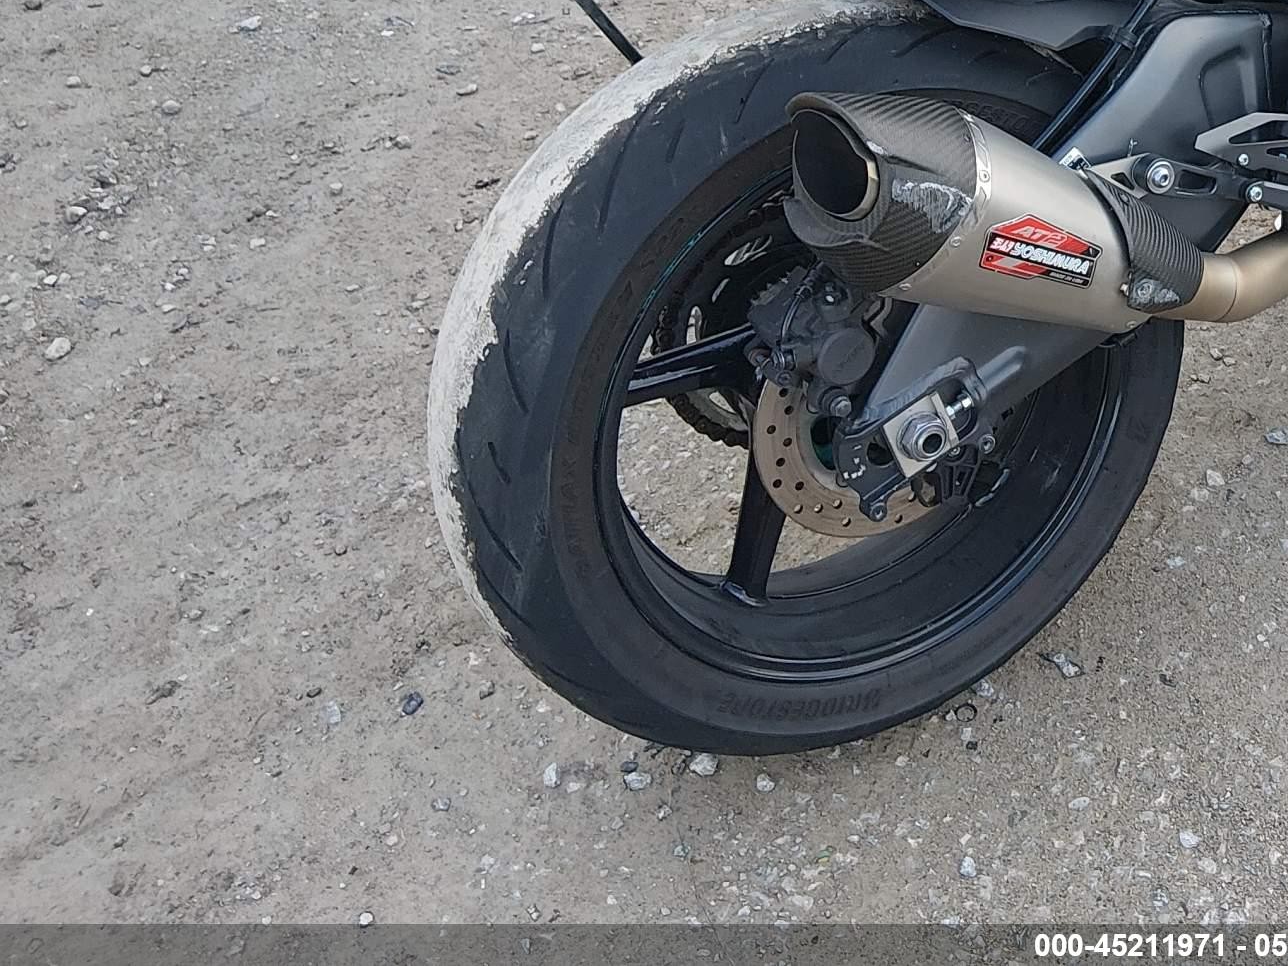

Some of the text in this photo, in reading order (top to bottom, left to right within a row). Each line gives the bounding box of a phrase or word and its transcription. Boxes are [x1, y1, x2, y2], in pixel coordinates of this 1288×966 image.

[1011, 225, 1068, 248] AT2
[1010, 241, 1091, 275] YOSHIMURA
[718, 688, 882, 721] BRIDGESTONE
